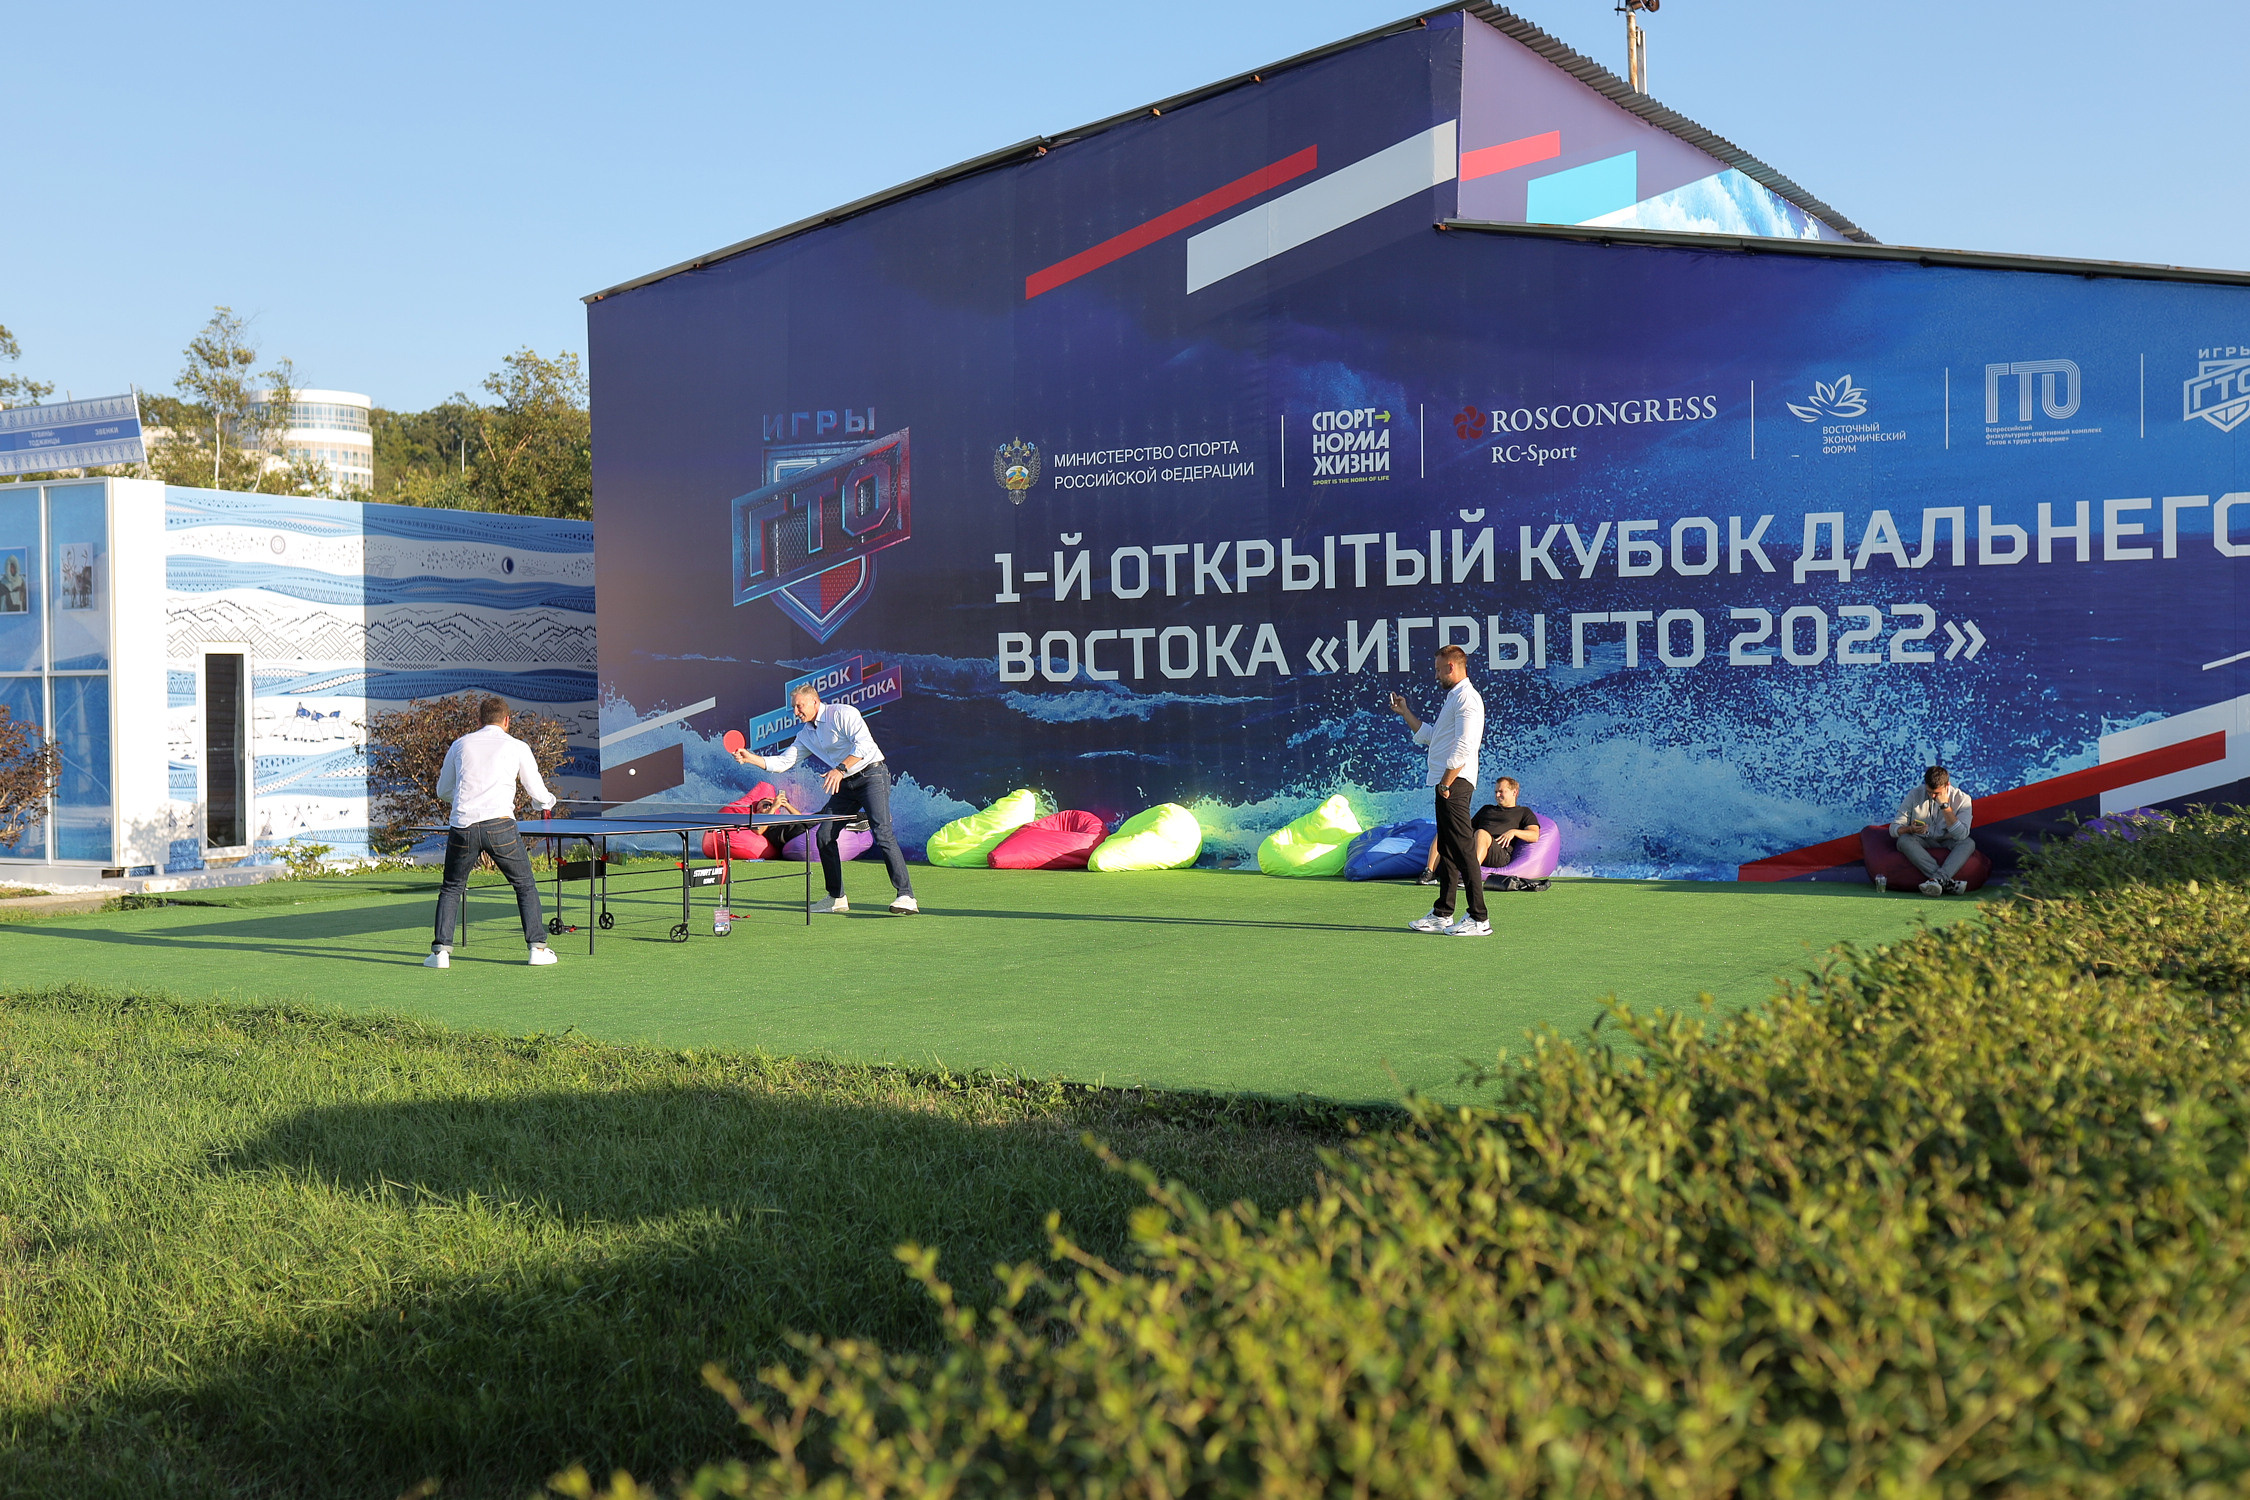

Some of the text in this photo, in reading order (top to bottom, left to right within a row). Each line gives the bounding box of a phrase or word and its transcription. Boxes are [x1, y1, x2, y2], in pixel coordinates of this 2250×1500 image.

[1985, 358, 2081, 423] ГТО
[763, 407, 876, 441] ИГРЫ
[1312, 407, 1376, 432] СПОРТ
[1491, 395, 1717, 433] ROSCONGRESS
[1822, 422, 1880, 435] ВОСТОЧНЫЙ
[1822, 430, 1906, 445] ЭКОНОМИЧЕСКИЙ
[1985, 424, 2033, 433] Всероссийский
[1054, 440, 1239, 467] МИНИСТЕРСТВО СПОРТА
[1312, 429, 1390, 454] НОРМА
[1822, 445, 1857, 454] ФОРУМ
[2013, 438, 2031, 446] труду
[1312, 451, 1390, 476] ЖИЗНИ
[1491, 443, 1577, 467] RC-Sport
[1054, 461, 1254, 489] РОССИЙСКОЙ ФЕДЕРАЦИИ
[749, 458, 891, 577] ГТО
[994, 492, 2250, 603] 1-Й ОТКРЫТЫЙ КУБОК ДАЛЬНЕГО
[998, 603, 1987, 682] ВОСТОКА «ИГРЫ ГТО 2022»
